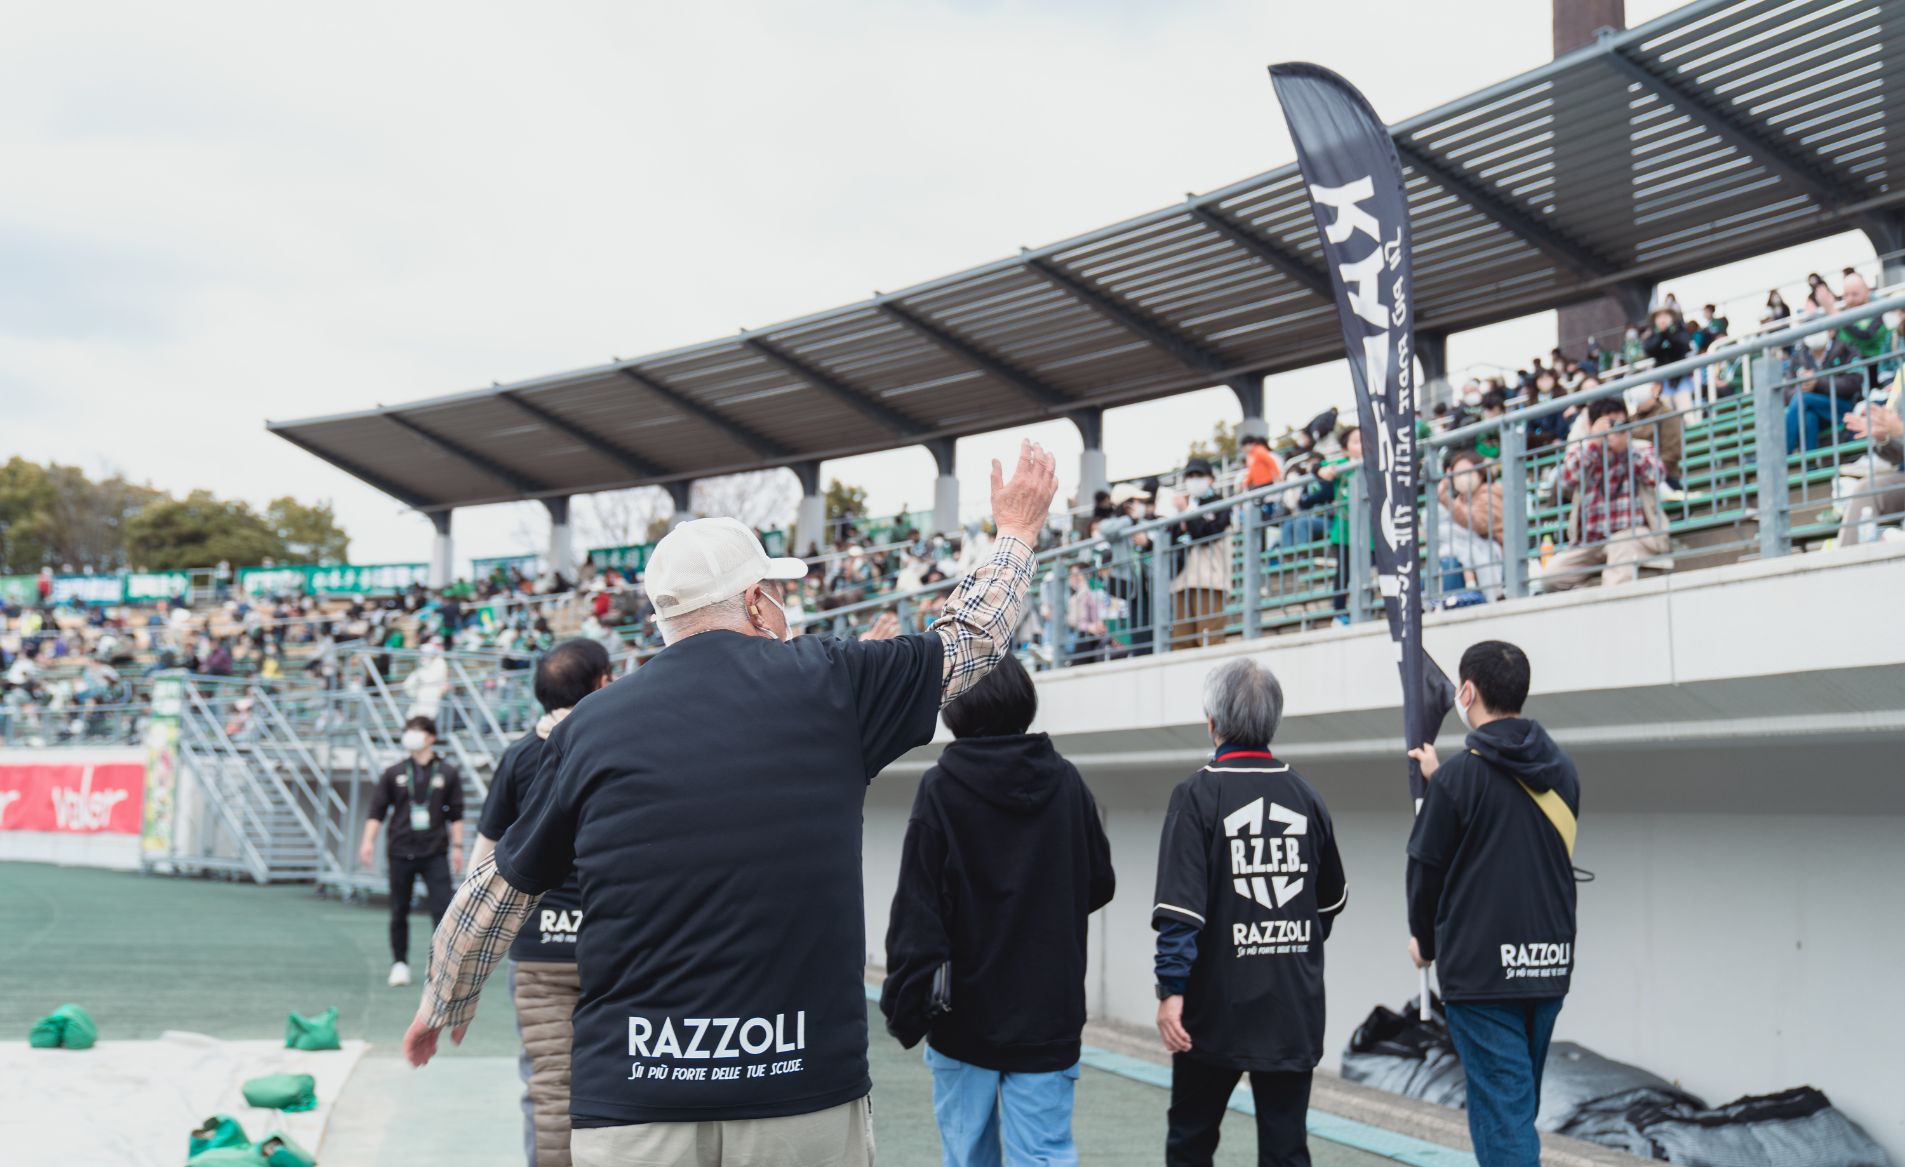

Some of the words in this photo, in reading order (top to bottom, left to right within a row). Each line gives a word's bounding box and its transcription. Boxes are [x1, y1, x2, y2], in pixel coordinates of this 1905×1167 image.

[1230, 837, 1308, 875] R.Z.F.B.
[1232, 919, 1311, 946] RAZZOLI
[1500, 942, 1570, 967] RAZZOLI
[628, 1010, 805, 1059] RAZZOLI
[647, 1064, 668, 1080] PIÙ
[672, 1067, 708, 1081] FORTE
[711, 1066, 742, 1081] DELLE
[746, 1064, 767, 1079] TUE
[770, 1058, 804, 1076] SCUSE.
